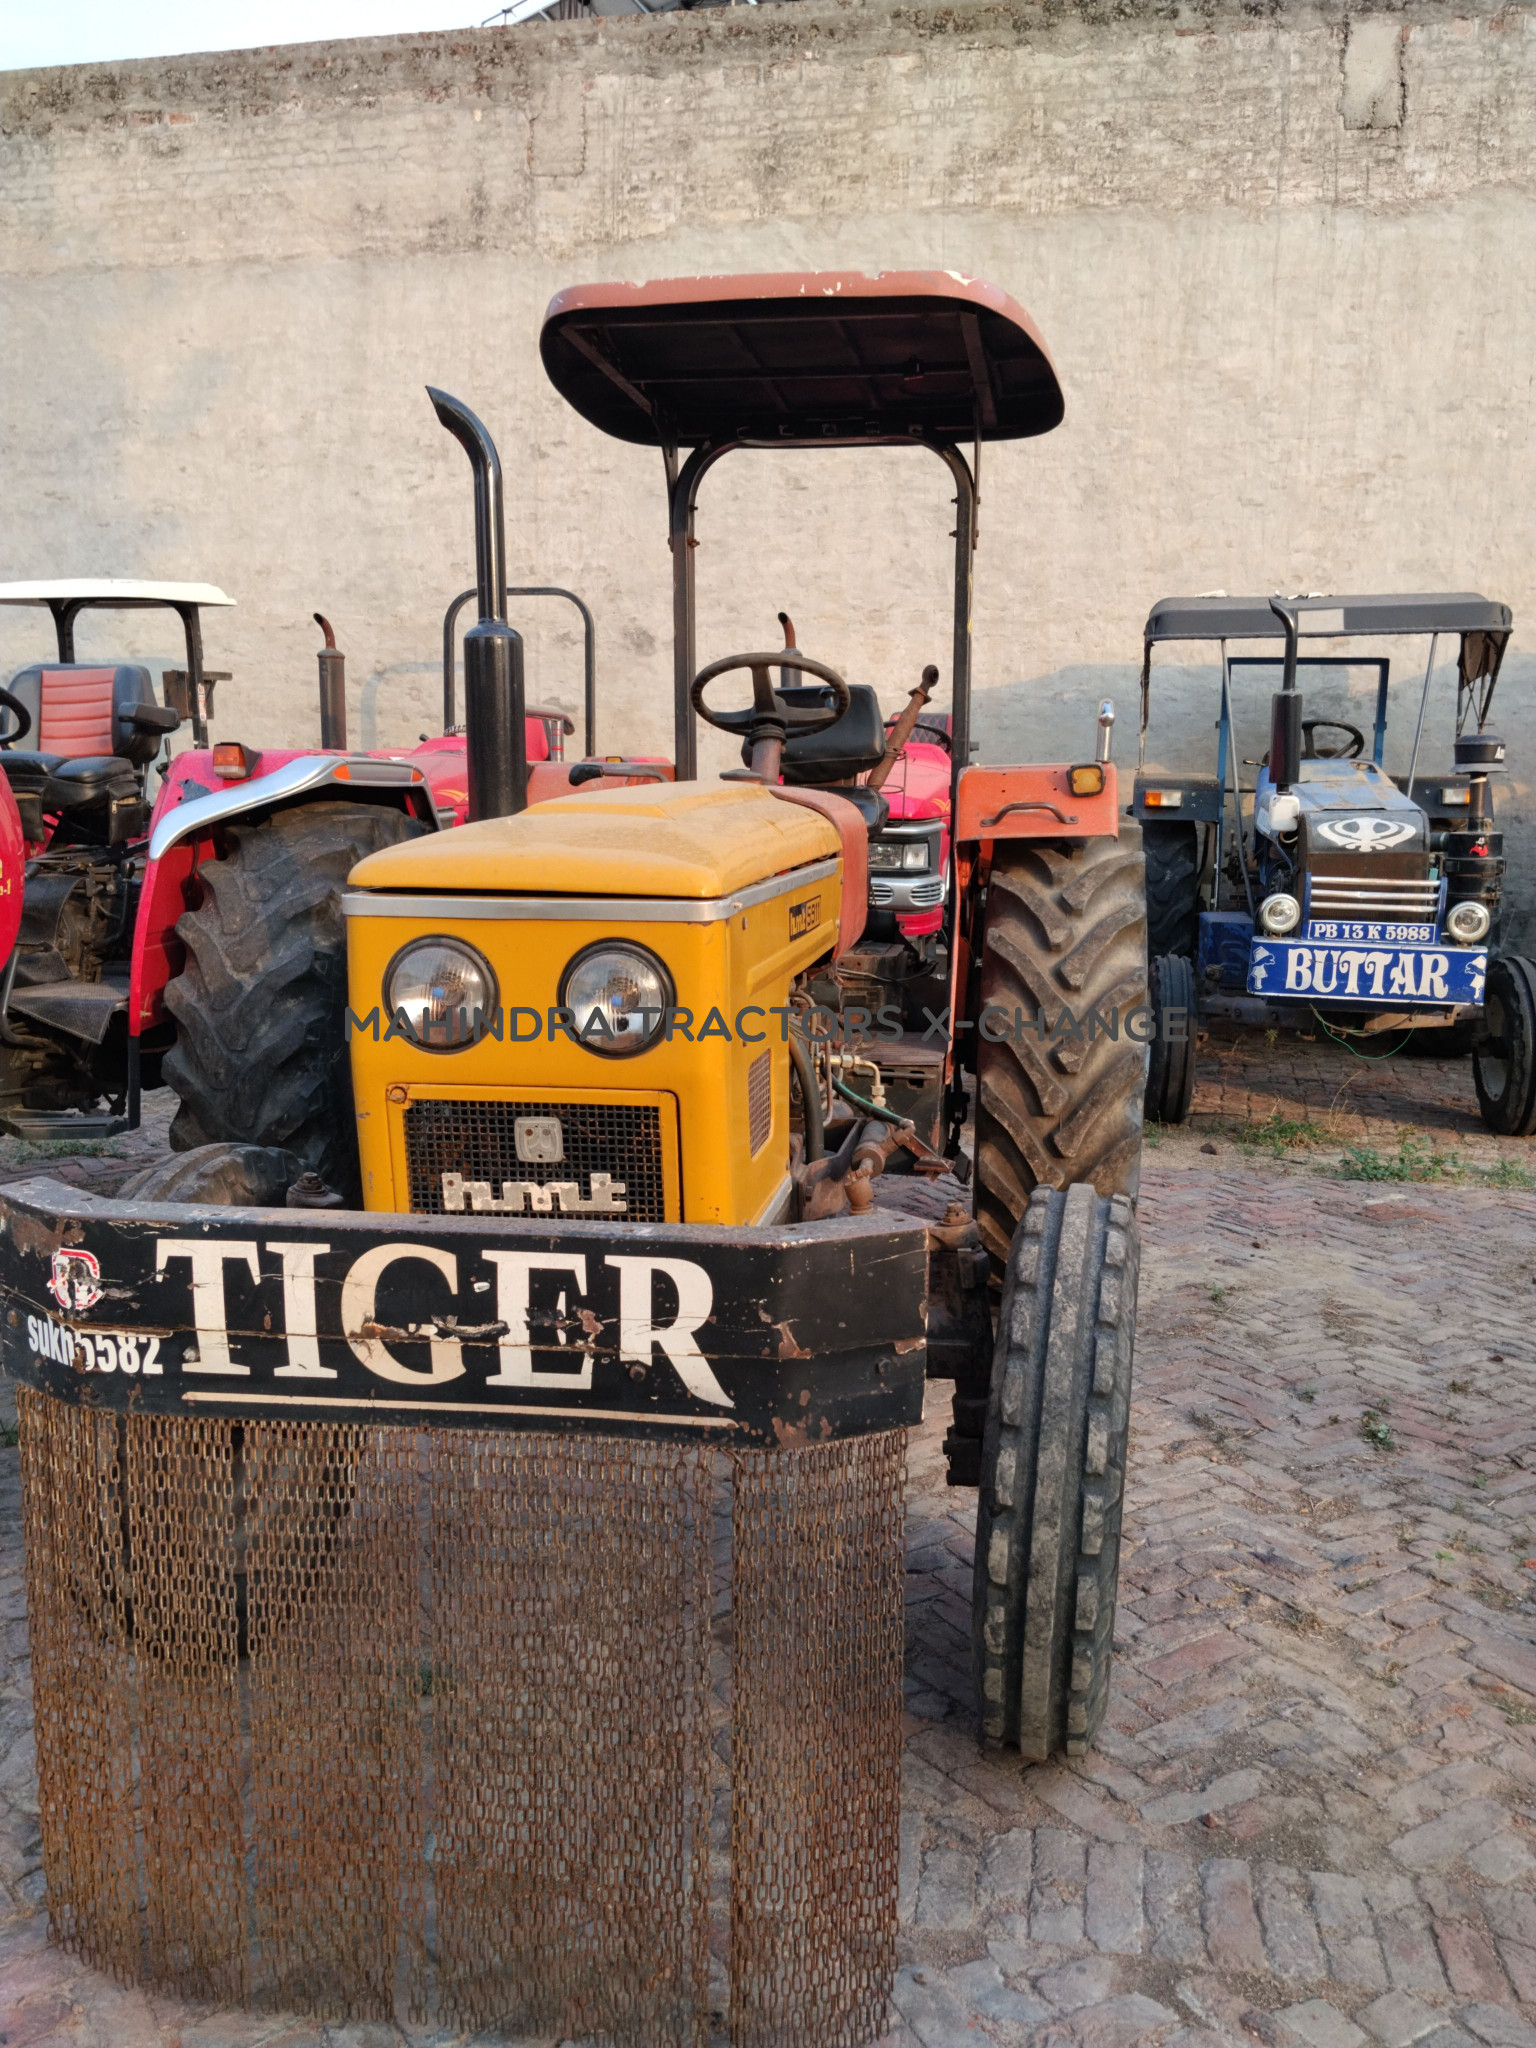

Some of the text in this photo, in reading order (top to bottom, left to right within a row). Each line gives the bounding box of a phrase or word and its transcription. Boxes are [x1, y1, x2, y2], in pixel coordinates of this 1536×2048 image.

[1314, 923, 1430, 942] PB 13 K 5988
[1285, 947, 1449, 1000] BUTTAR
[442, 1172, 627, 1212] hmt
[156, 1238, 735, 1409] TIGER
